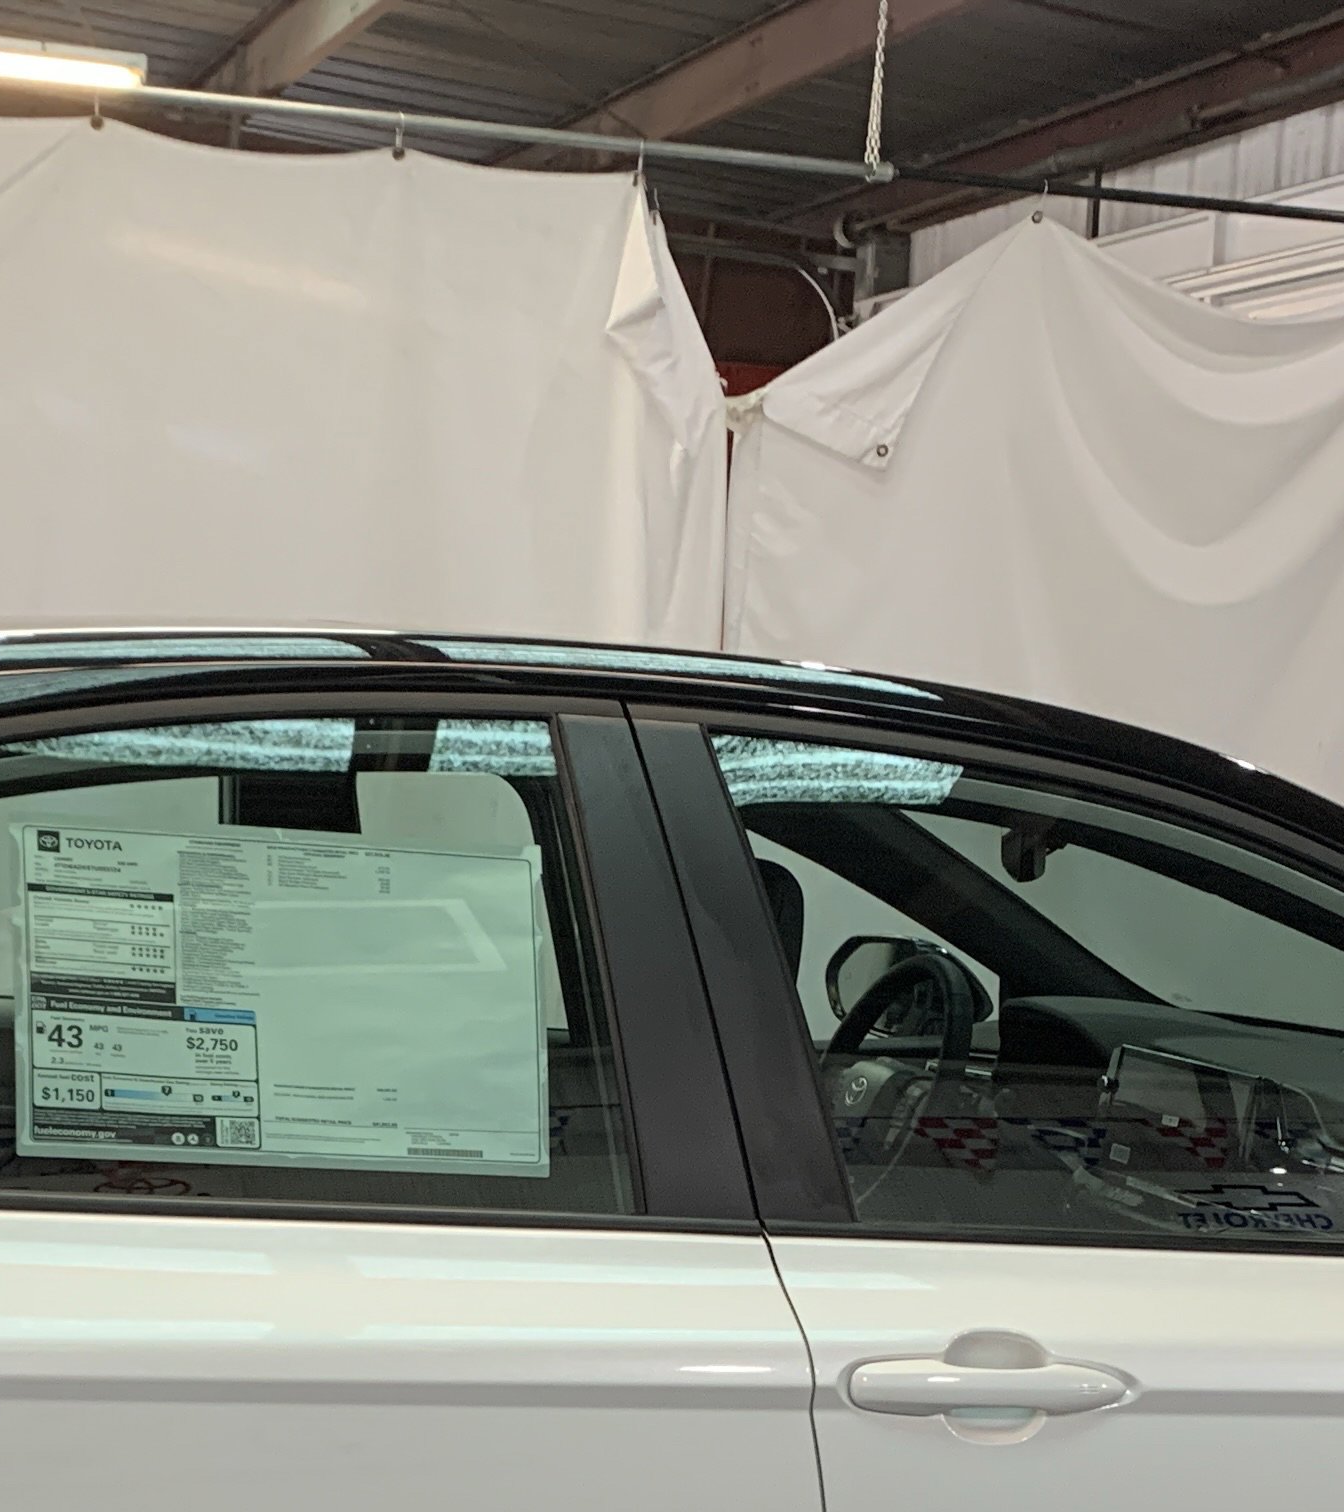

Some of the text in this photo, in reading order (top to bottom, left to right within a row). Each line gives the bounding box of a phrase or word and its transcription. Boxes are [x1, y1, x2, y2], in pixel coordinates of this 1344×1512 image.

[65, 837, 123, 852] TOYOTA
[50, 1000, 67, 1009] Fuel
[68, 1002, 106, 1013] Economy
[107, 1004, 122, 1013] and
[89, 1024, 109, 1033] MPG
[199, 1027, 224, 1035] save
[47, 1024, 84, 1049] 43
[93, 1042, 104, 1050] 43
[112, 1043, 123, 1052] 43
[186, 1036, 239, 1052] $2,750
[71, 1074, 95, 1082] cost
[41, 1086, 95, 1103] $1,150
[34, 1125, 117, 1139] fueleconomy.gov
